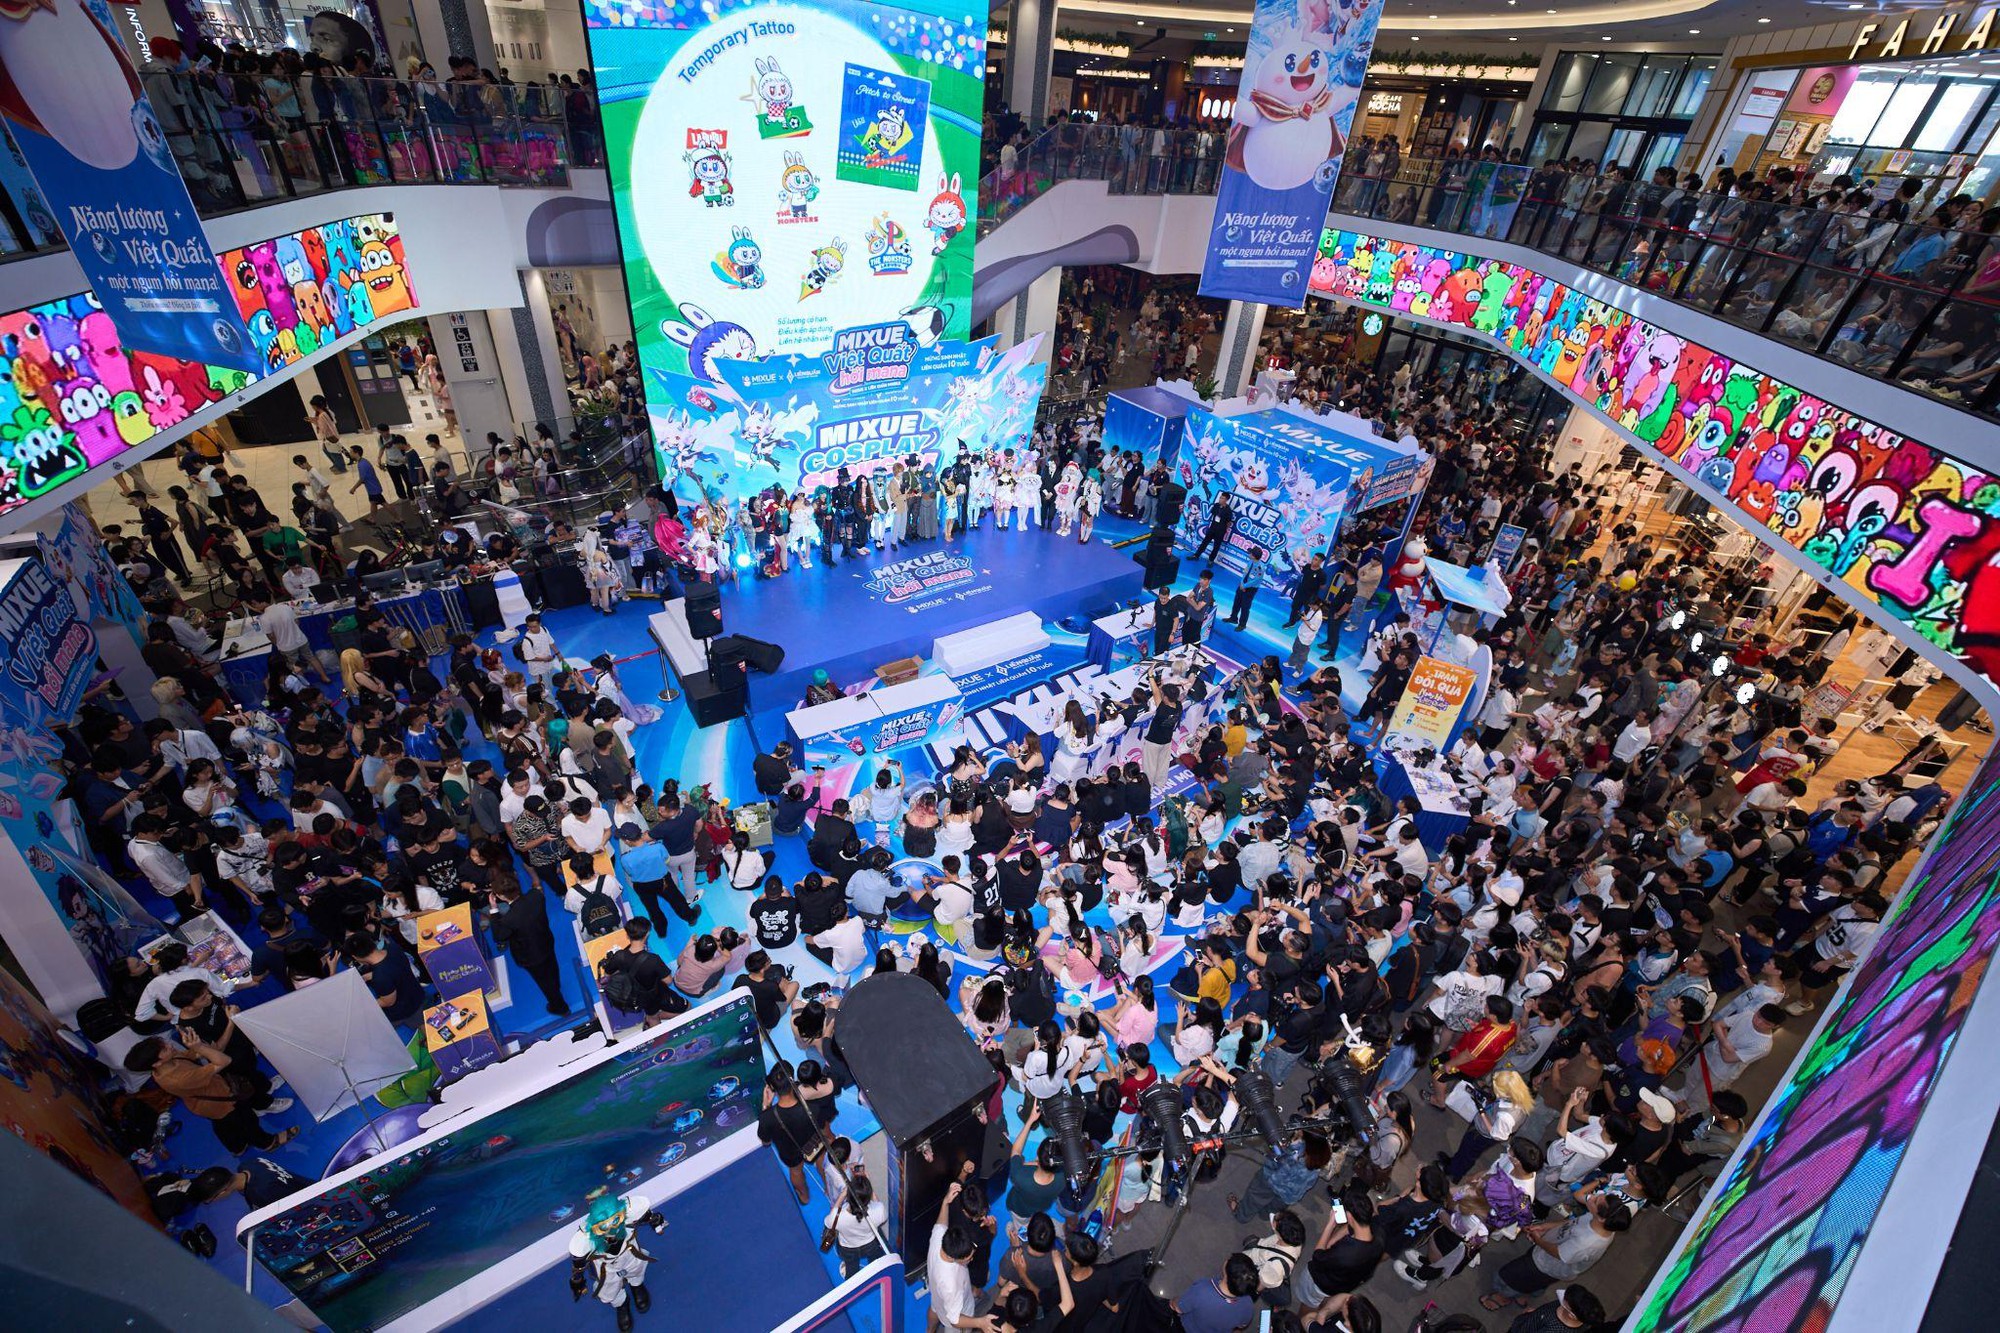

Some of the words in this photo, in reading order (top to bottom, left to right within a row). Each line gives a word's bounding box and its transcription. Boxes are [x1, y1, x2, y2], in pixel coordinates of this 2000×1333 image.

[1848, 8, 1997, 60] FAHA
[678, 28, 748, 82] Temporary
[749, 21, 795, 37] Tattoo
[882, 92, 890, 100] to
[1368, 100, 1401, 111] MOCHA
[69, 205, 120, 242] Năng
[115, 202, 168, 236] lượng
[776, 210, 791, 219] THE
[777, 216, 819, 225] MONSTERS
[1215, 212, 1260, 232] Năng
[1260, 211, 1299, 229] lượng
[1250, 229, 1277, 246] Việt
[1275, 229, 1314, 245] Quất,
[122, 237, 162, 269] Việt
[162, 236, 212, 269] Quất,
[1281, 246, 1312, 257] mana!
[108, 273, 131, 293] một
[184, 273, 220, 292] mana!
[838, 326, 906, 352] MIXUE
[824, 349, 864, 374] Việt
[868, 341, 913, 365] Quất
[752, 373, 777, 383] MIXUE
[866, 365, 908, 381] mana
[820, 414, 919, 449] MIXUE
[1270, 423, 1374, 462] MIXUE
[803, 433, 934, 474] COSPLAY
[1236, 517, 1281, 550] Quất
[865, 571, 916, 594] Việt
[915, 556, 969, 578] Quất
[873, 551, 949, 579] MIXUE
[923, 569, 975, 587] mana
[0, 564, 52, 643] MIXUE
[11, 622, 50, 684] Việt
[41, 584, 76, 637] Quất
[54, 623, 86, 676] mana
[955, 673, 984, 688] IXUE
[1026, 667, 1037, 675] 10
[882, 711, 927, 731] MIXUE
[984, 882, 1000, 907] 21
[369, 1229, 393, 1243] Ability
[394, 1216, 419, 1230] Power
